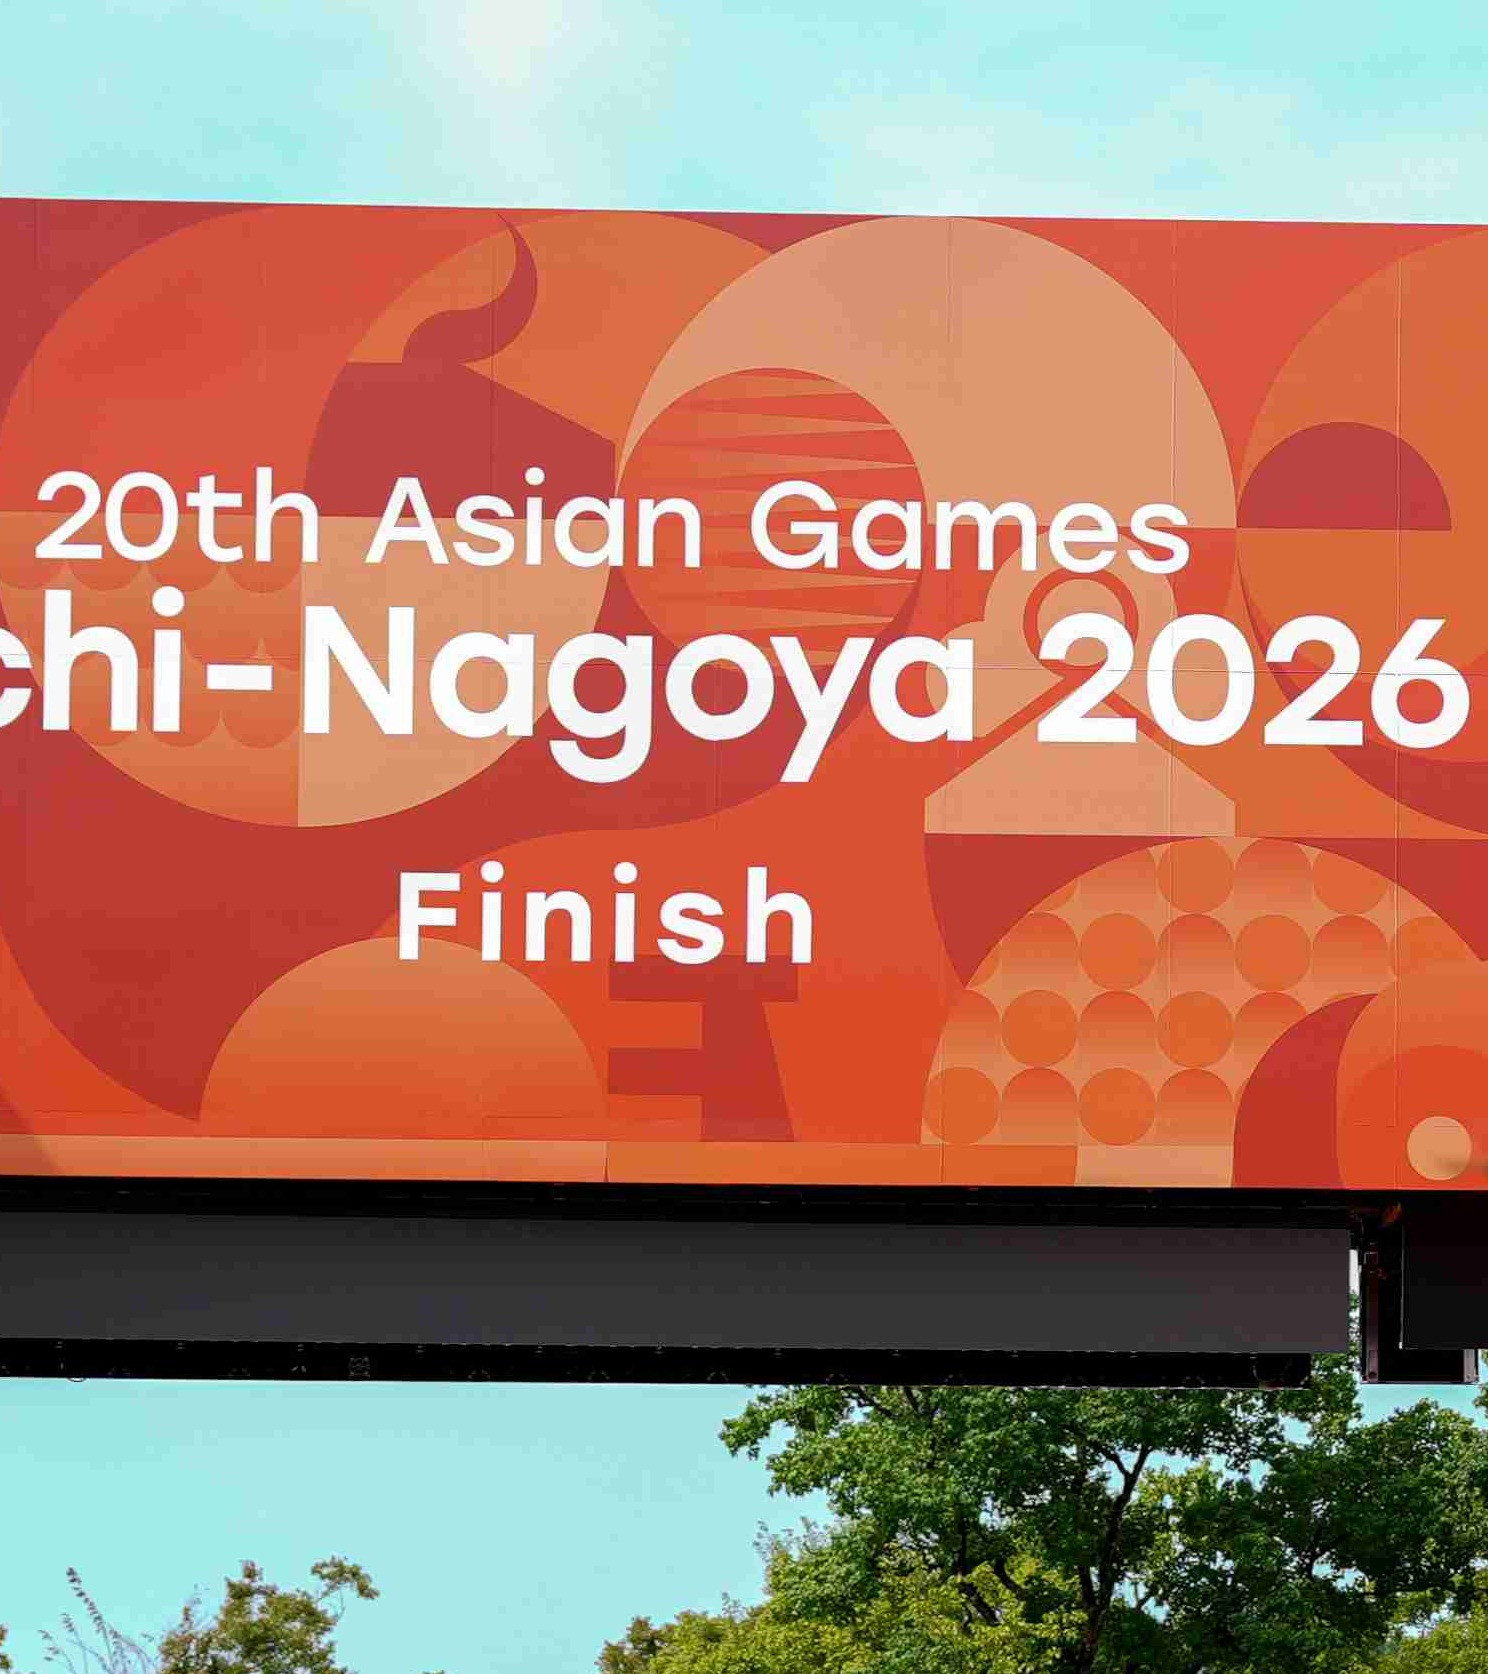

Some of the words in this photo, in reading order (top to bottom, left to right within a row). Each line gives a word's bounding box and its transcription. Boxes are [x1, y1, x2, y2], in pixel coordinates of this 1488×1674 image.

[34, 467, 322, 566] 20th
[367, 474, 703, 572] Asian
[751, 478, 1193, 578] Games
[1036, 612, 1471, 749] 2026
[398, 861, 815, 966] Finish
